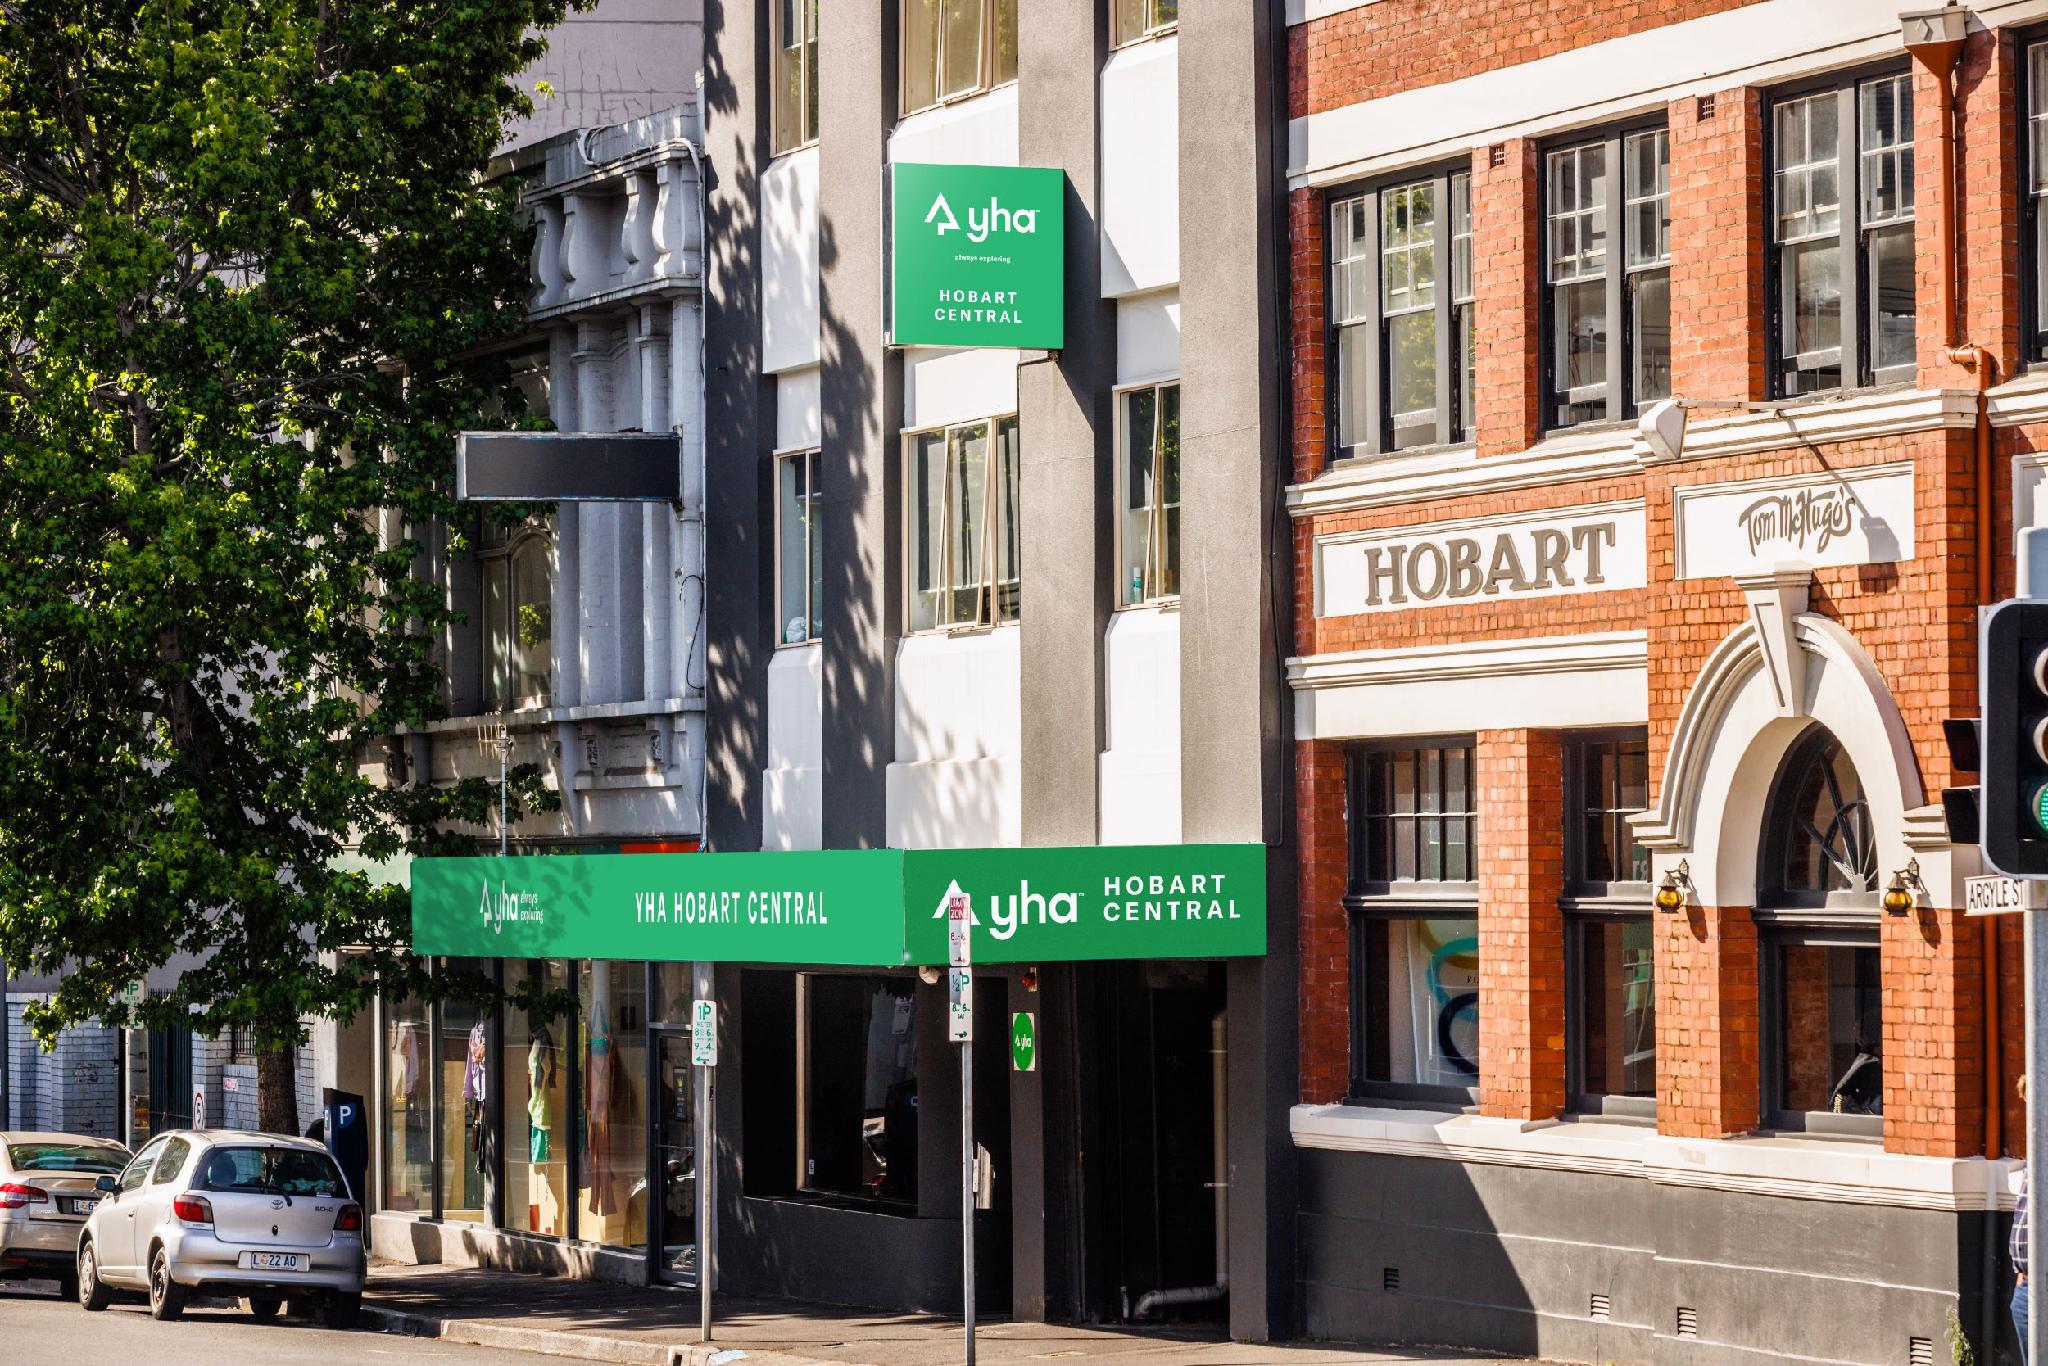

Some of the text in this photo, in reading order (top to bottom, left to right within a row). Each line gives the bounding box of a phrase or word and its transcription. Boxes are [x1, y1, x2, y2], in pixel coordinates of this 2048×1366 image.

[967, 197, 1037, 243] yha
[954, 255, 1011, 264] always exploring
[939, 290, 1017, 305] HOBART
[934, 308, 1022, 324] CENTRAL
[1738, 486, 1856, 557] Tom McHugo's
[1364, 521, 1616, 606] HOBART
[1104, 874, 1226, 896] HOBART
[1968, 879, 2024, 910] ARGYLE ST
[494, 880, 519, 935] yha
[521, 890, 538, 907] always
[635, 891, 828, 925] YHA HOBART CENTRAL
[989, 879, 1078, 940] yha
[520, 908, 544, 925] exploring
[1103, 899, 1241, 922] CENTRAL
[698, 1005, 711, 1020] 1P
[339, 1105, 352, 1125] P
[269, 1254, 281, 1266] 22
